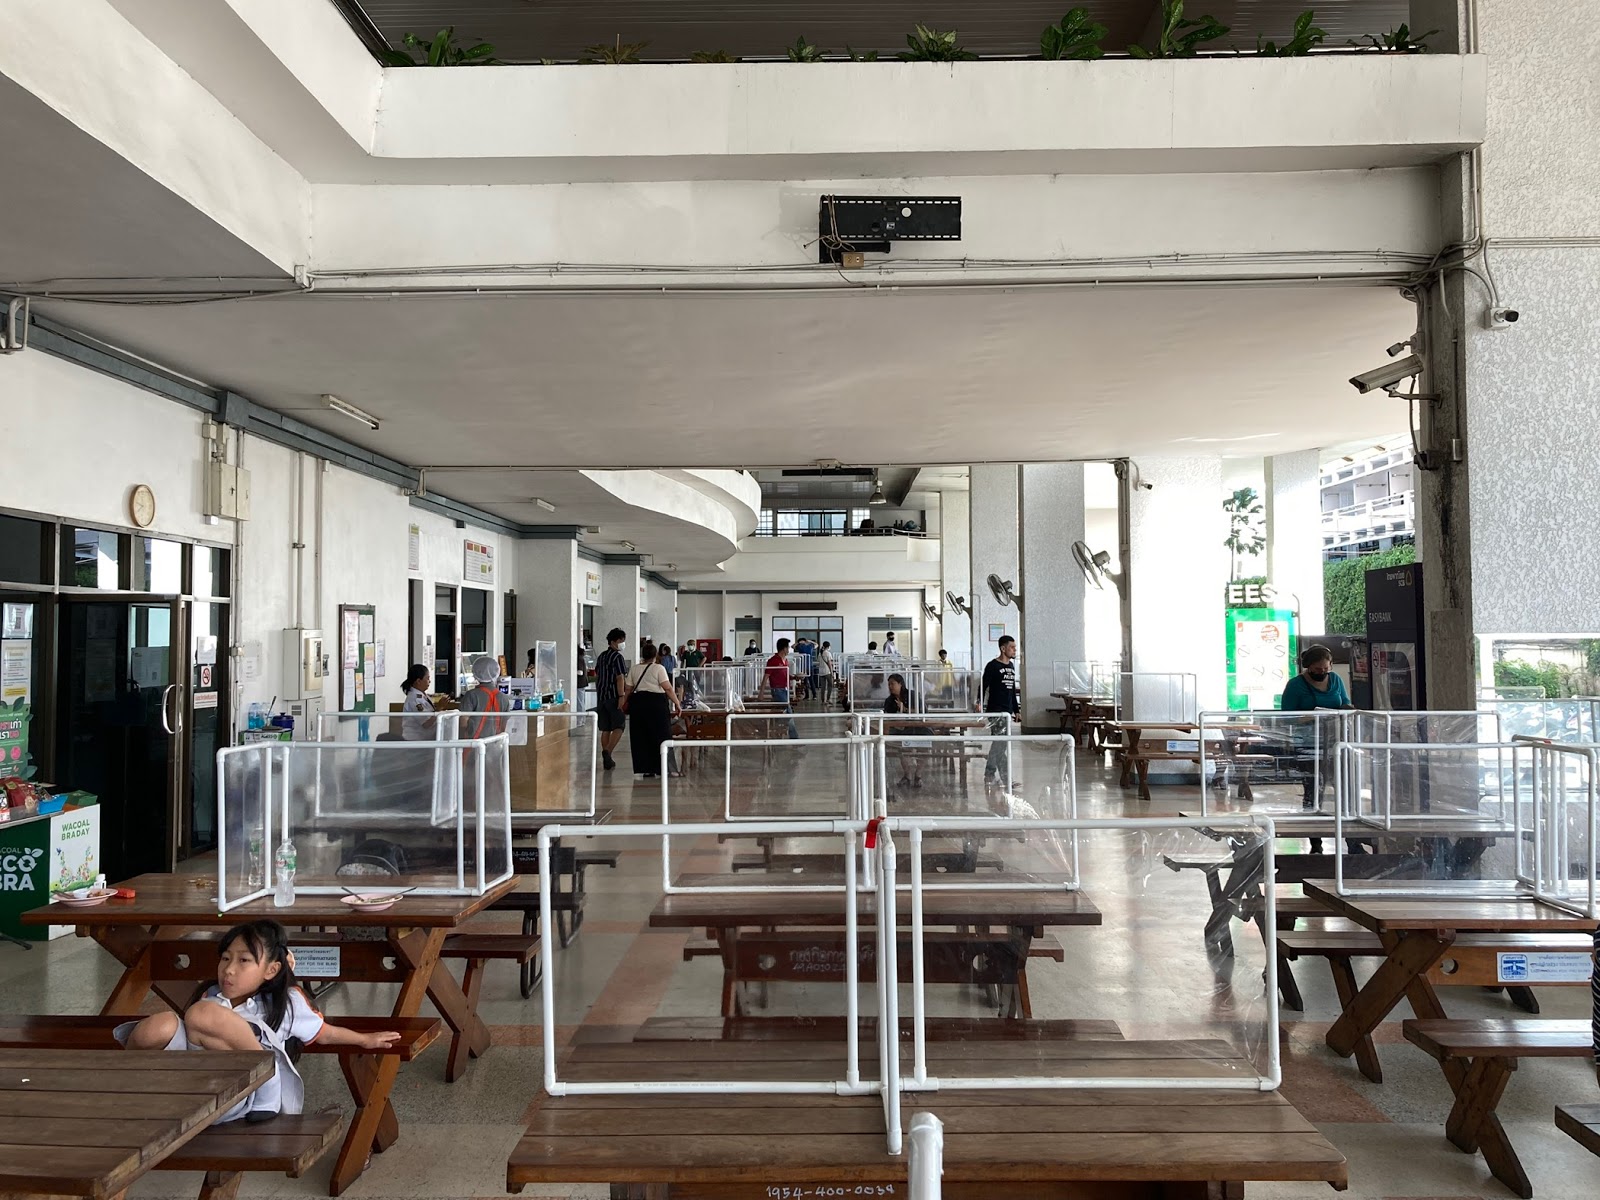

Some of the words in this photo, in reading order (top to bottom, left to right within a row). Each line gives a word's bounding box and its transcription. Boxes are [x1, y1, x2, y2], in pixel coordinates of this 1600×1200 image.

[1369, 612, 1392, 622] EASYBANK
[62, 819, 90, 832] WACOAL
[61, 828, 90, 841] BRADAY
[0, 873, 35, 891] RA
